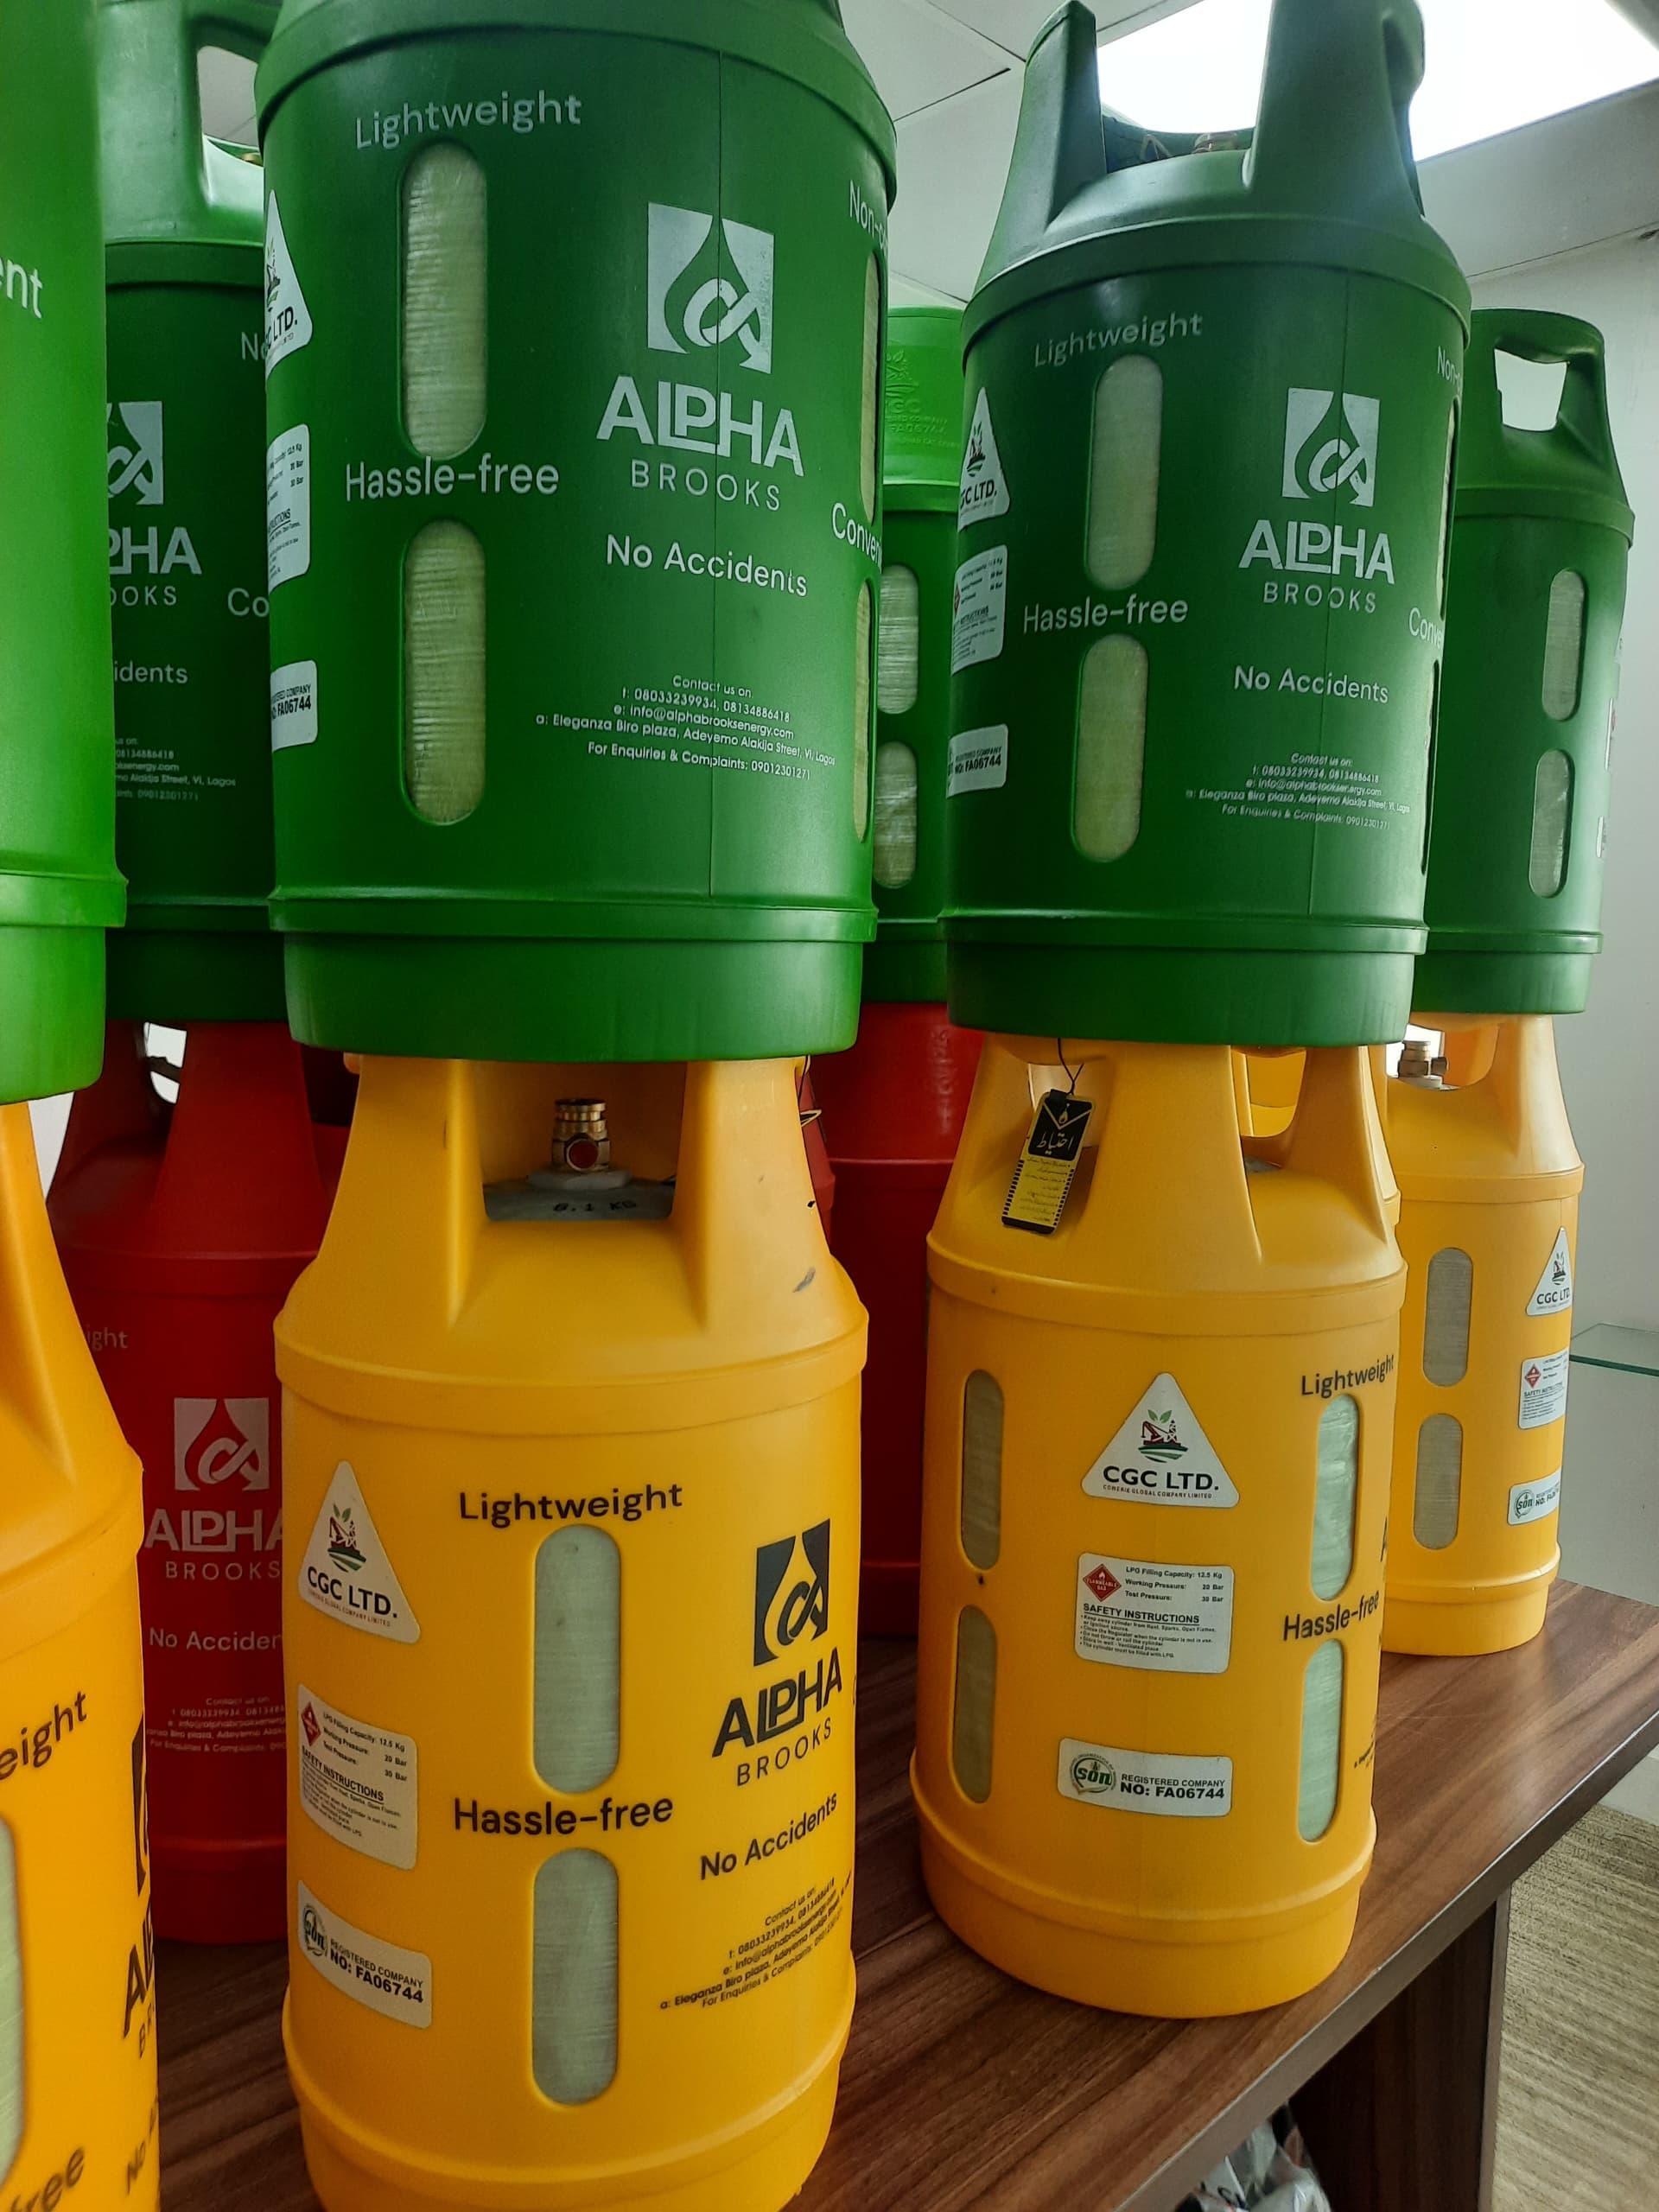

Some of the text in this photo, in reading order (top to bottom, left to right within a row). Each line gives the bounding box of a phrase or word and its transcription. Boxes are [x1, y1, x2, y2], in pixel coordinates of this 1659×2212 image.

[355, 90, 582, 149] Lightweight
[1034, 311, 1204, 368] Lightweight
[595, 374, 804, 477] ALPHA
[346, 453, 560, 502] Hassle-free
[630, 458, 781, 512] BROOKS
[606, 532, 808, 598] No Accidents
[1237, 518, 1395, 585] ALPHA
[1023, 593, 1189, 635] Hassle-free
[1263, 581, 1376, 614] BROOKS
[672, 674, 735, 696] Contact us
[1234, 664, 1389, 704] No Accidents
[277, 694, 312, 717] FA06744
[629, 703, 795, 741] info@alphabrooksenergy.com
[723, 700, 790, 723] 08134886418
[552, 713, 613, 732] Eleganza
[616, 718, 639, 734] Biro
[642, 722, 680, 741] plaza,
[683, 727, 739, 747] Adeyemo
[741, 735, 774, 753] Alakija
[774, 741, 802, 760] Street,
[815, 751, 836, 767] Lagos
[588, 741, 810, 780] For Enquiries & Complaints: 09012301271
[1536, 1290, 1558, 1305] CGC
[1300, 1353, 1395, 1400] Lightweight
[1102, 1465, 1219, 1491] CGC LTD.
[1157, 1490, 1187, 1499] COMPANY
[1187, 1491, 1212, 1500] LIMITED
[459, 1482, 683, 1529] Lightweight
[165, 1560, 281, 1581] BROOKS
[1125, 1578, 1154, 1590] Working
[1154, 1581, 1187, 1592] Pressure:
[1212, 1583, 1224, 1592] Bar
[1141, 1567, 1164, 1578] Filling
[1163, 1569, 1196, 1580] Capacity:
[1198, 1571, 1211, 1580] 12.5
[1212, 1571, 1224, 1580] Kg
[307, 1565, 343, 1601] CGC
[348, 1584, 397, 1619] LTD.
[1141, 1591, 1173, 1602] Pressure:
[1211, 1595, 1224, 1604] Bar
[1083, 1602, 1200, 1624] SAFETY INSTRUCTIONS
[1282, 1588, 1380, 1642] Hassle-free
[149, 1627, 179, 1649] No
[711, 1646, 842, 1758] ALPHA
[395, 1741, 405, 1754] Kg
[736, 1716, 832, 1788] BROOKS
[322, 1763, 385, 1802] INSTRUCTIONS
[1120, 1781, 1225, 1800] NO: FA06744
[1121, 1773, 1226, 1789] REGISTERED COMPANY
[454, 1796, 674, 1836] Hassle-free
[700, 1791, 837, 1881] No Accidents
[329, 1937, 424, 1989] REGISTERED COMPANY
[329, 1948, 424, 2005] NO: FA06744
[660, 1999, 671, 2011] a:
[674, 1982, 723, 2007] Eleganza
[725, 1974, 743, 1989] Biro
[701, 1996, 718, 2009] For
